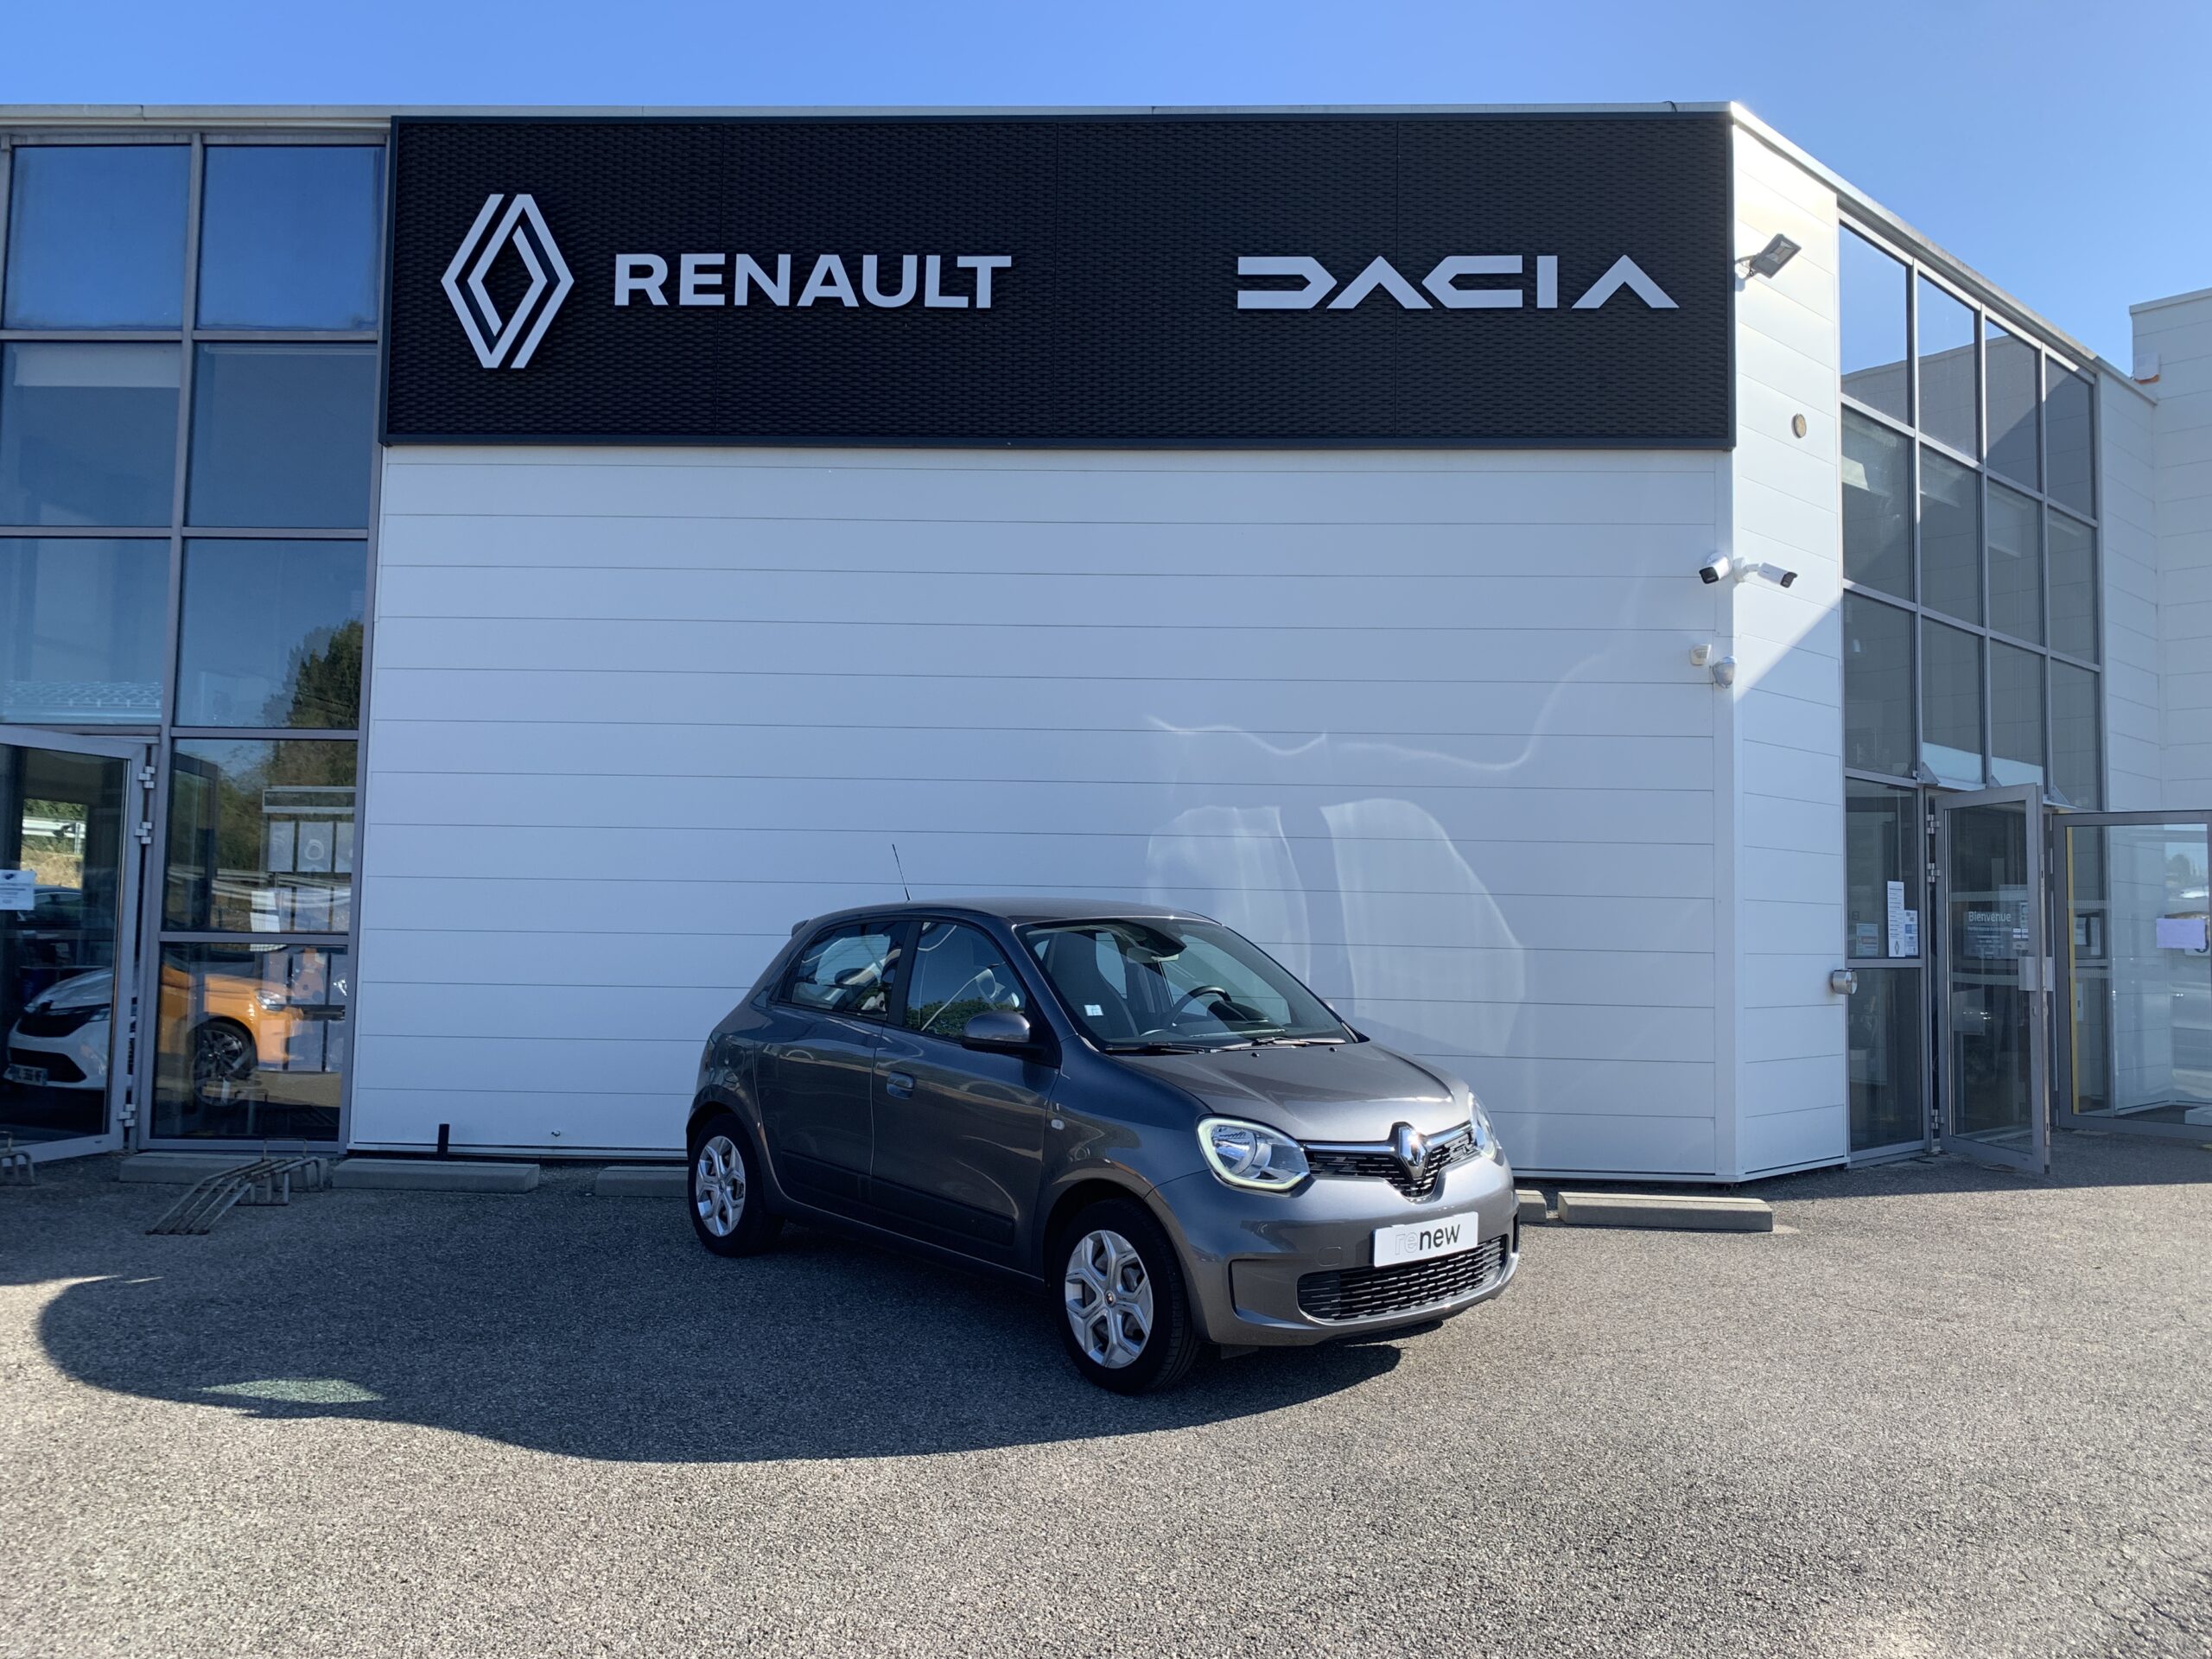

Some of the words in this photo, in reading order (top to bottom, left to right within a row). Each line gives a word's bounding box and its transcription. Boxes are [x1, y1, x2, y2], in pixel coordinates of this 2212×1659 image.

[614, 254, 1012, 308] RENAULT
[1237, 255, 1680, 309] DACIA
[1968, 911, 2012, 922] Bienvenue
[1395, 1224, 1460, 1255] renew
